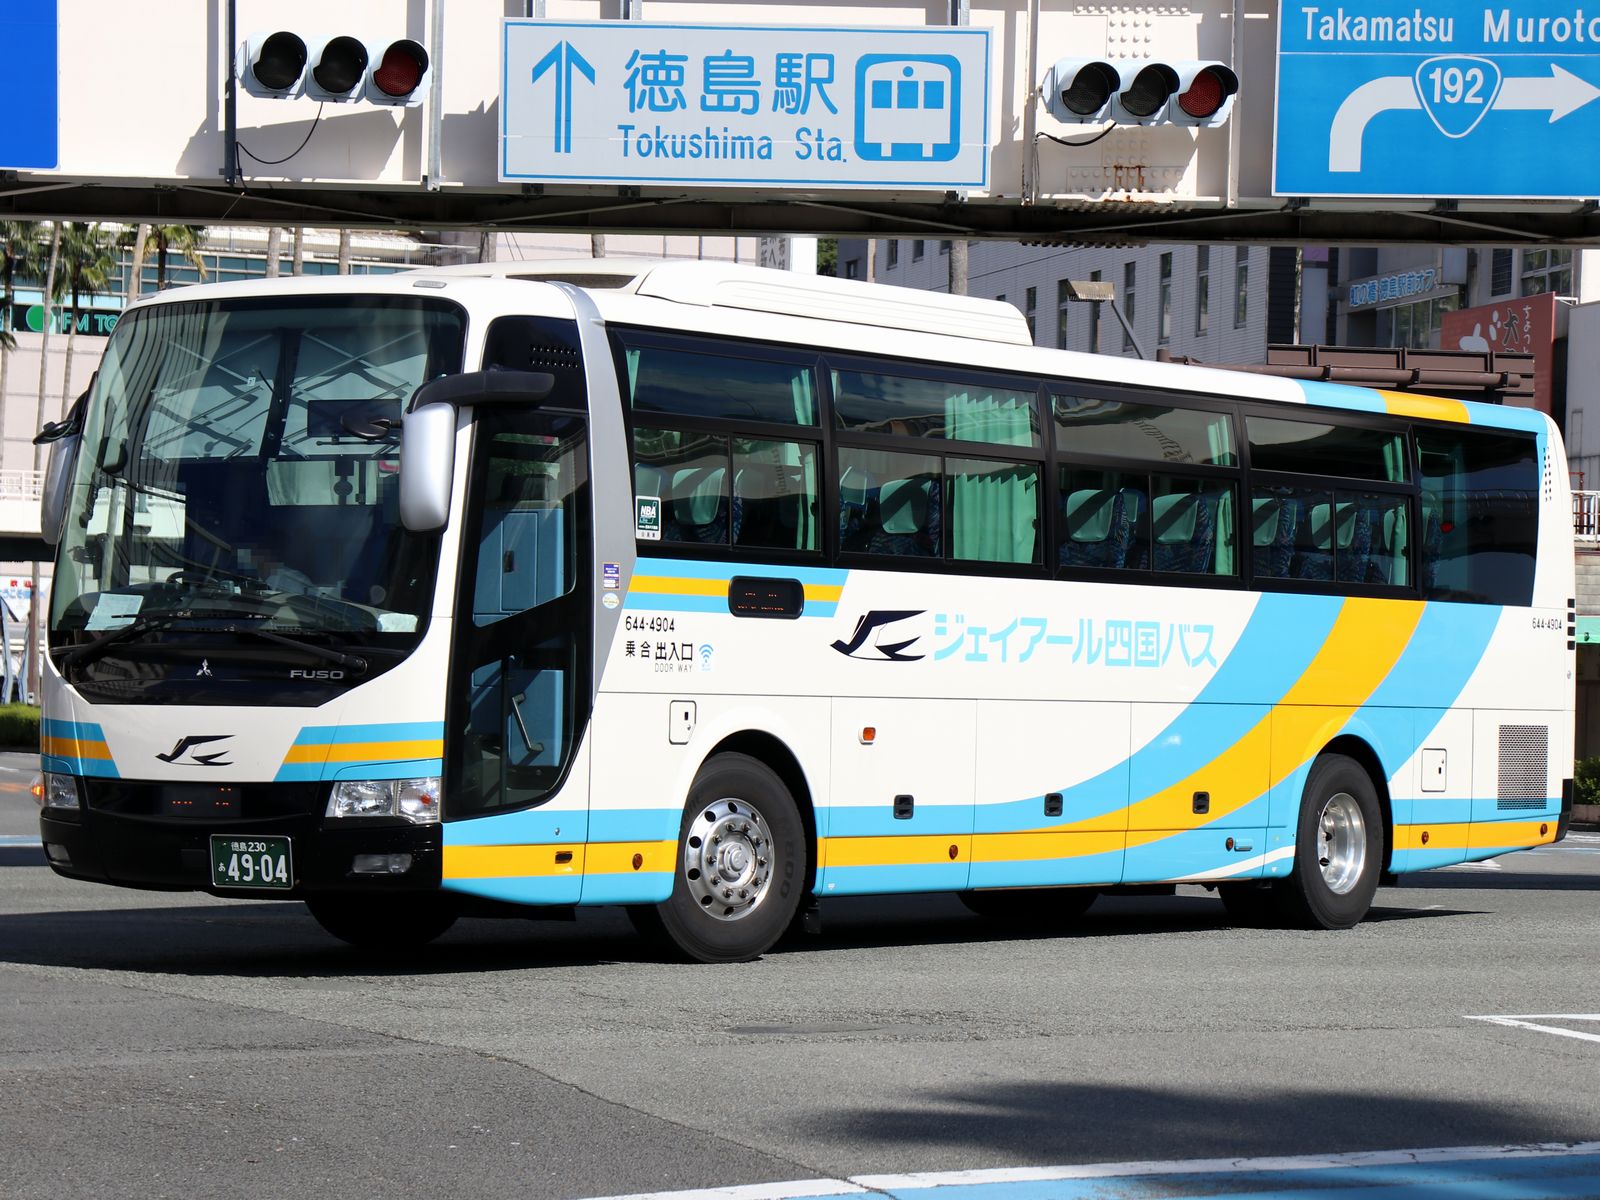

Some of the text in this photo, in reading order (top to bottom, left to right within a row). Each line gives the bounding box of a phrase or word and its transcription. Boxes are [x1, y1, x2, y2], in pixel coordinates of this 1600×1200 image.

[1302, 7, 1454, 41] Takamatsu
[623, 49, 838, 115] 徳島駅
[1429, 67, 1484, 104] 192
[617, 124, 847, 162] Tokushima Sta.
[640, 505, 656, 518] NBA
[625, 615, 675, 632] 644-4904
[934, 613, 1218, 669] ジェイアール四国バス
[290, 670, 344, 679] FUSO
[655, 662, 674, 672] DOOR
[678, 663, 693, 672] WAY
[228, 853, 288, 883] 49-04
